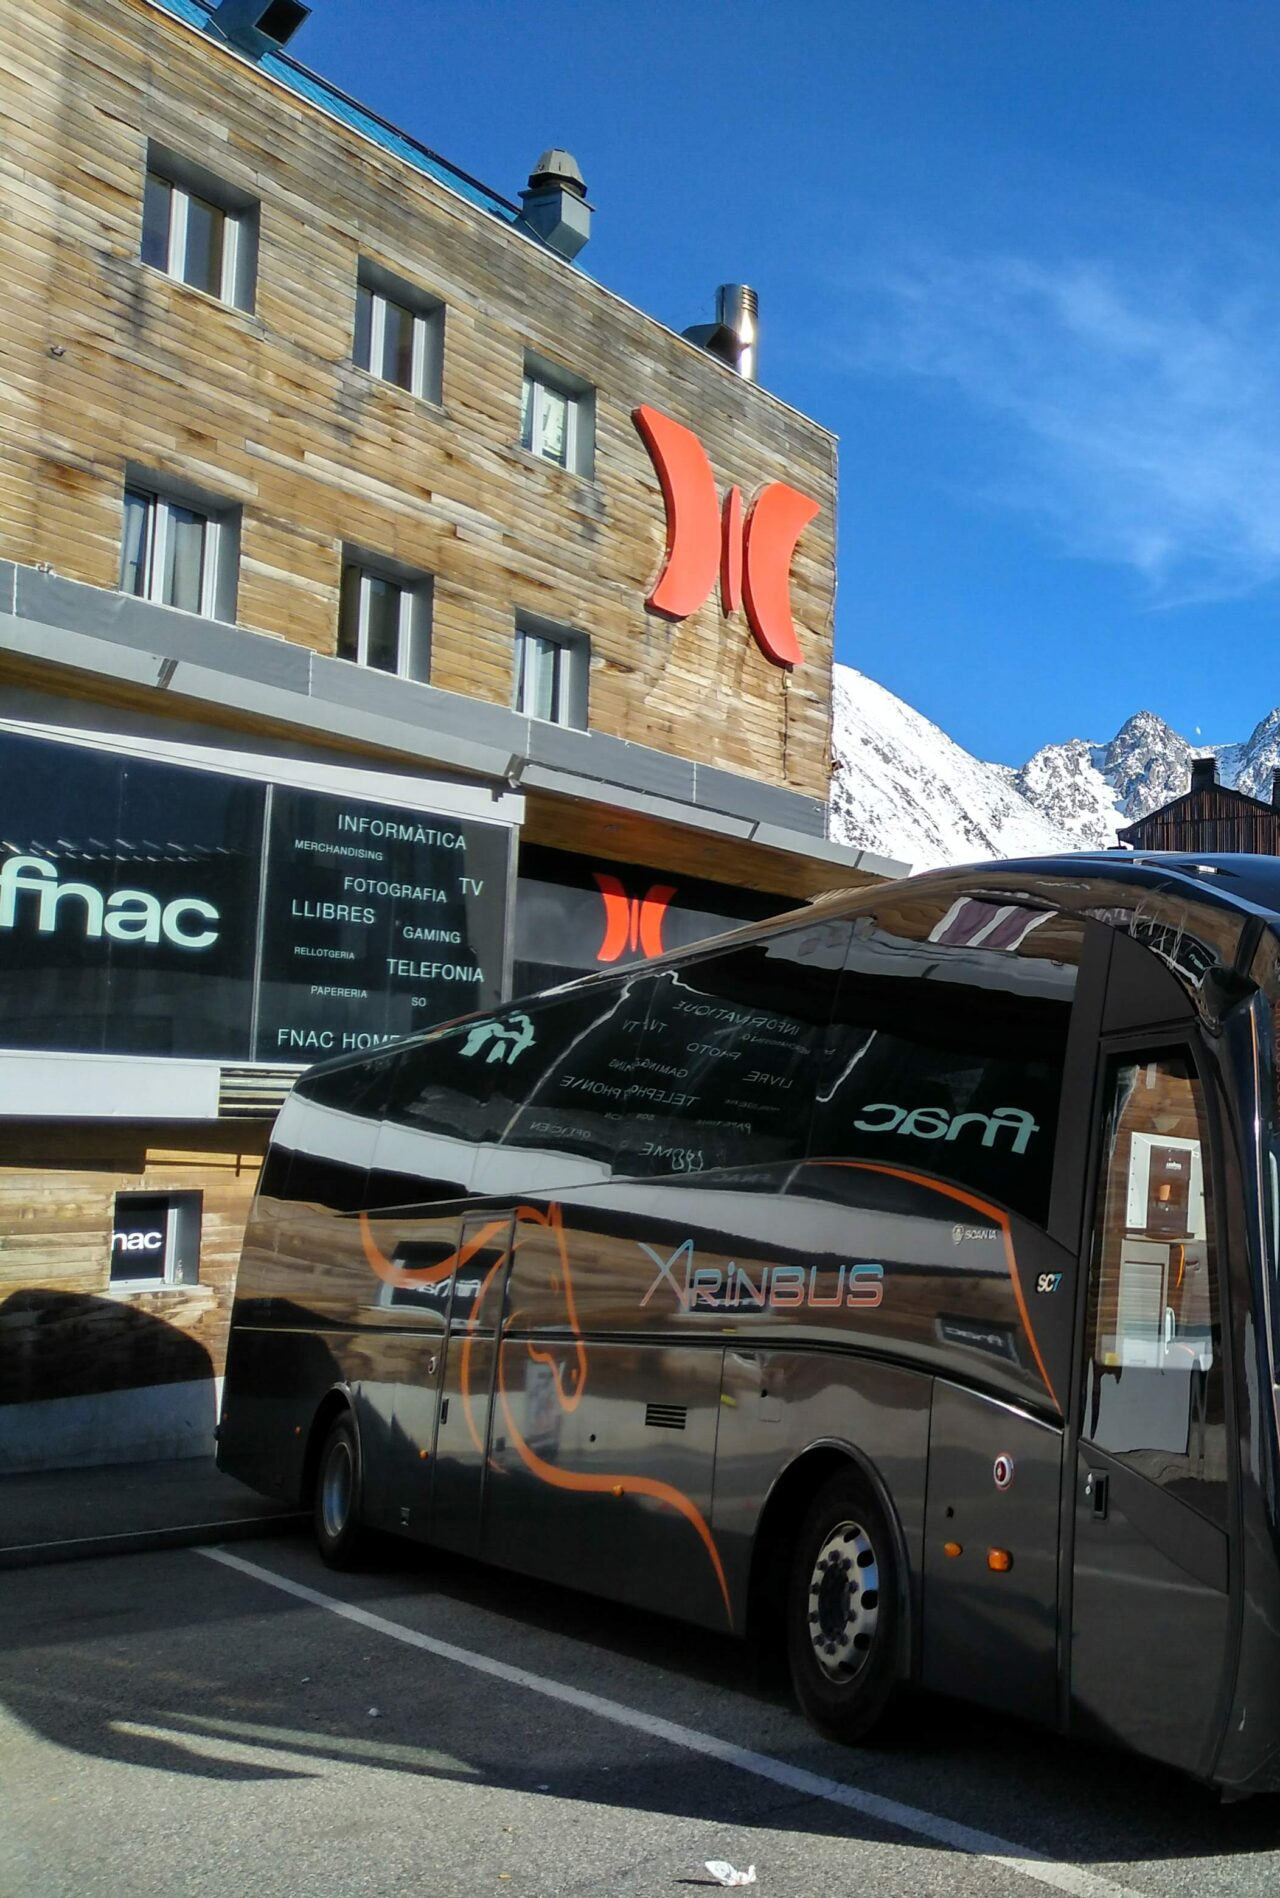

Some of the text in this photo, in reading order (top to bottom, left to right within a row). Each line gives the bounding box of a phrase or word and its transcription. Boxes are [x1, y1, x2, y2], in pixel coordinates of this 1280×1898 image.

[338, 814, 467, 851] INFORMÀTICA
[294, 839, 384, 861] MERCHANDISING
[343, 876, 447, 903] FOTOGRAFIA
[459, 877, 484, 897] TV
[0, 855, 219, 948] fnac
[291, 899, 376, 926] LLIBRES
[402, 926, 462, 944] GAMING
[293, 946, 355, 960] RELLOTGERIA
[386, 958, 485, 983] TELEFONIA
[310, 985, 368, 999] PAPERERIA
[410, 996, 427, 1008] SO
[277, 1029, 335, 1050] FNAC
[965, 1229, 997, 1240] SCANIA
[1037, 1273, 1063, 1292] SC7
